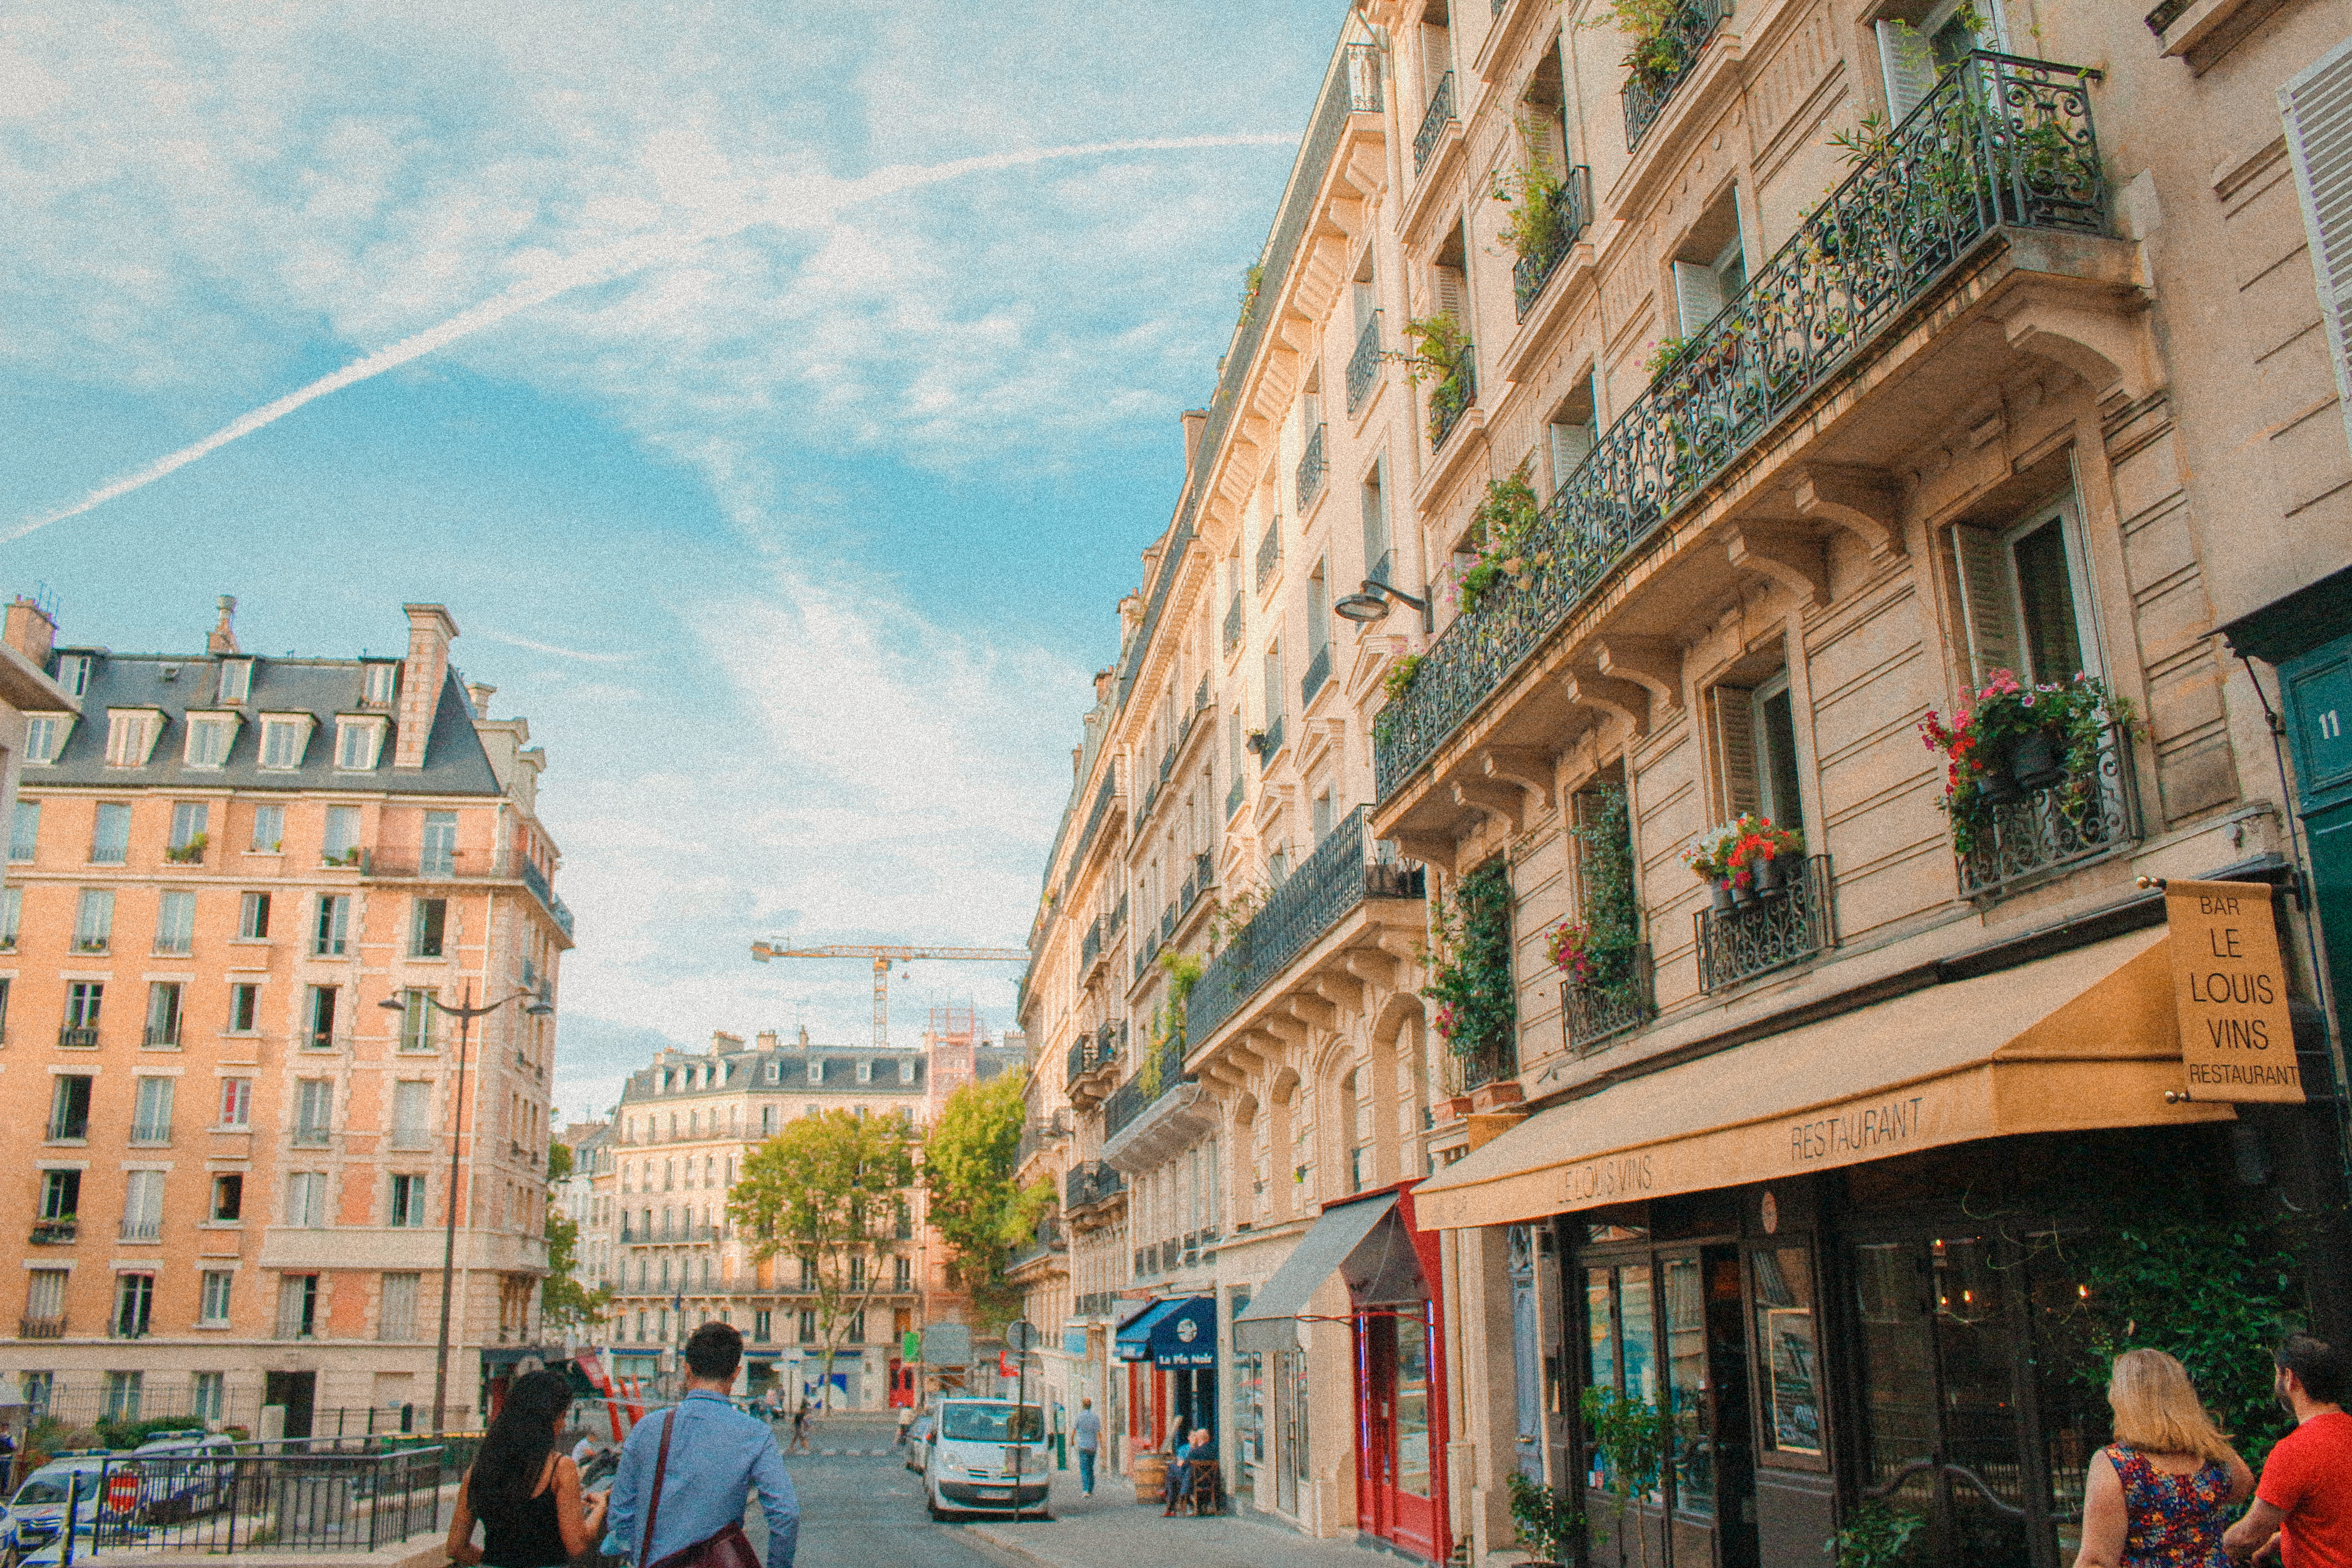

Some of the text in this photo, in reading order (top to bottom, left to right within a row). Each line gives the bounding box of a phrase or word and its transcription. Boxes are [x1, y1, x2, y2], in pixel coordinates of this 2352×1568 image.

[2319, 710, 2341, 739] 11
[2200, 897, 2240, 915] BAR
[2210, 928, 2242, 957] LE
[2190, 973, 2274, 1004] LOUIS
[2207, 1019, 2269, 1050] VINS
[2190, 1064, 2297, 1085] RESTAURANT
[1792, 1097, 1923, 1161] RESTAURANT
[1618, 1154, 1652, 1192] VINS
